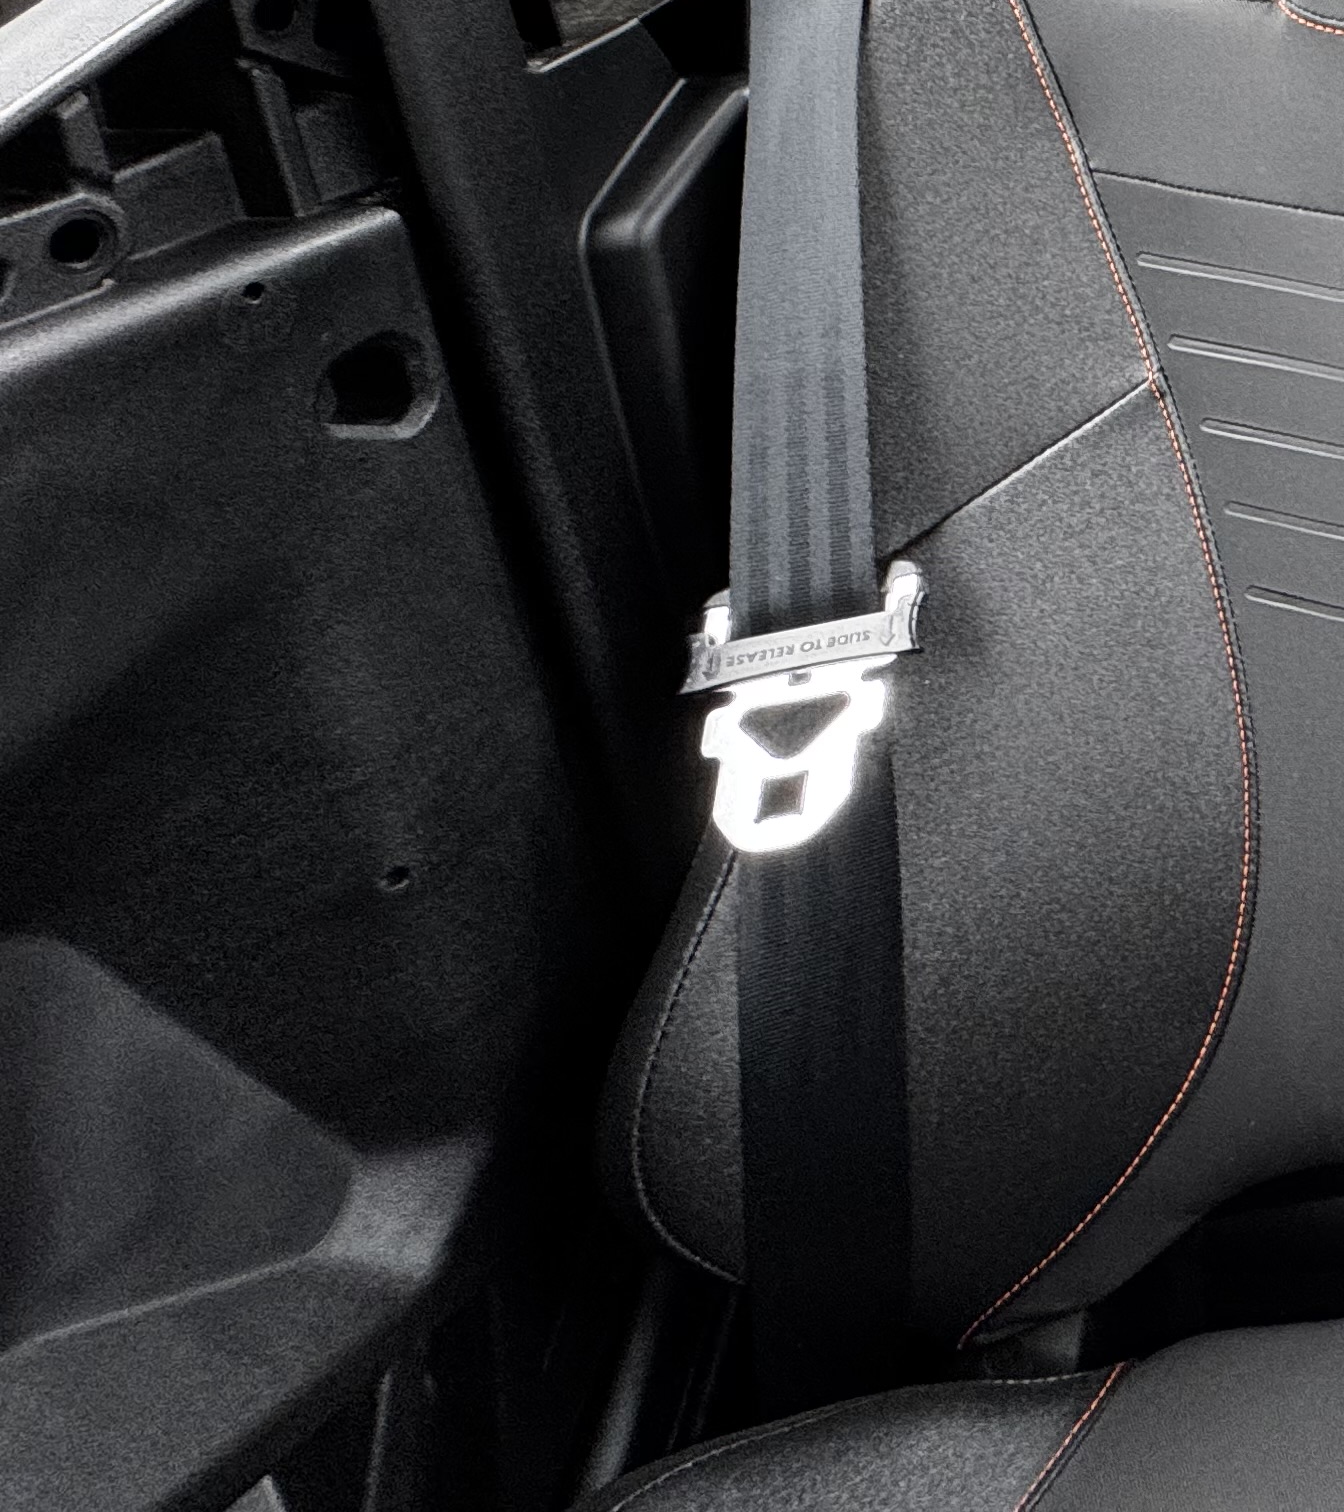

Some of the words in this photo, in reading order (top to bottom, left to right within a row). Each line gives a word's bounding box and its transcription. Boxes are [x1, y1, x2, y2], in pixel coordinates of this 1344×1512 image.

[800, 640, 823, 653] TO
[827, 629, 872, 648] SLIDE
[726, 643, 796, 667] RELEASE
